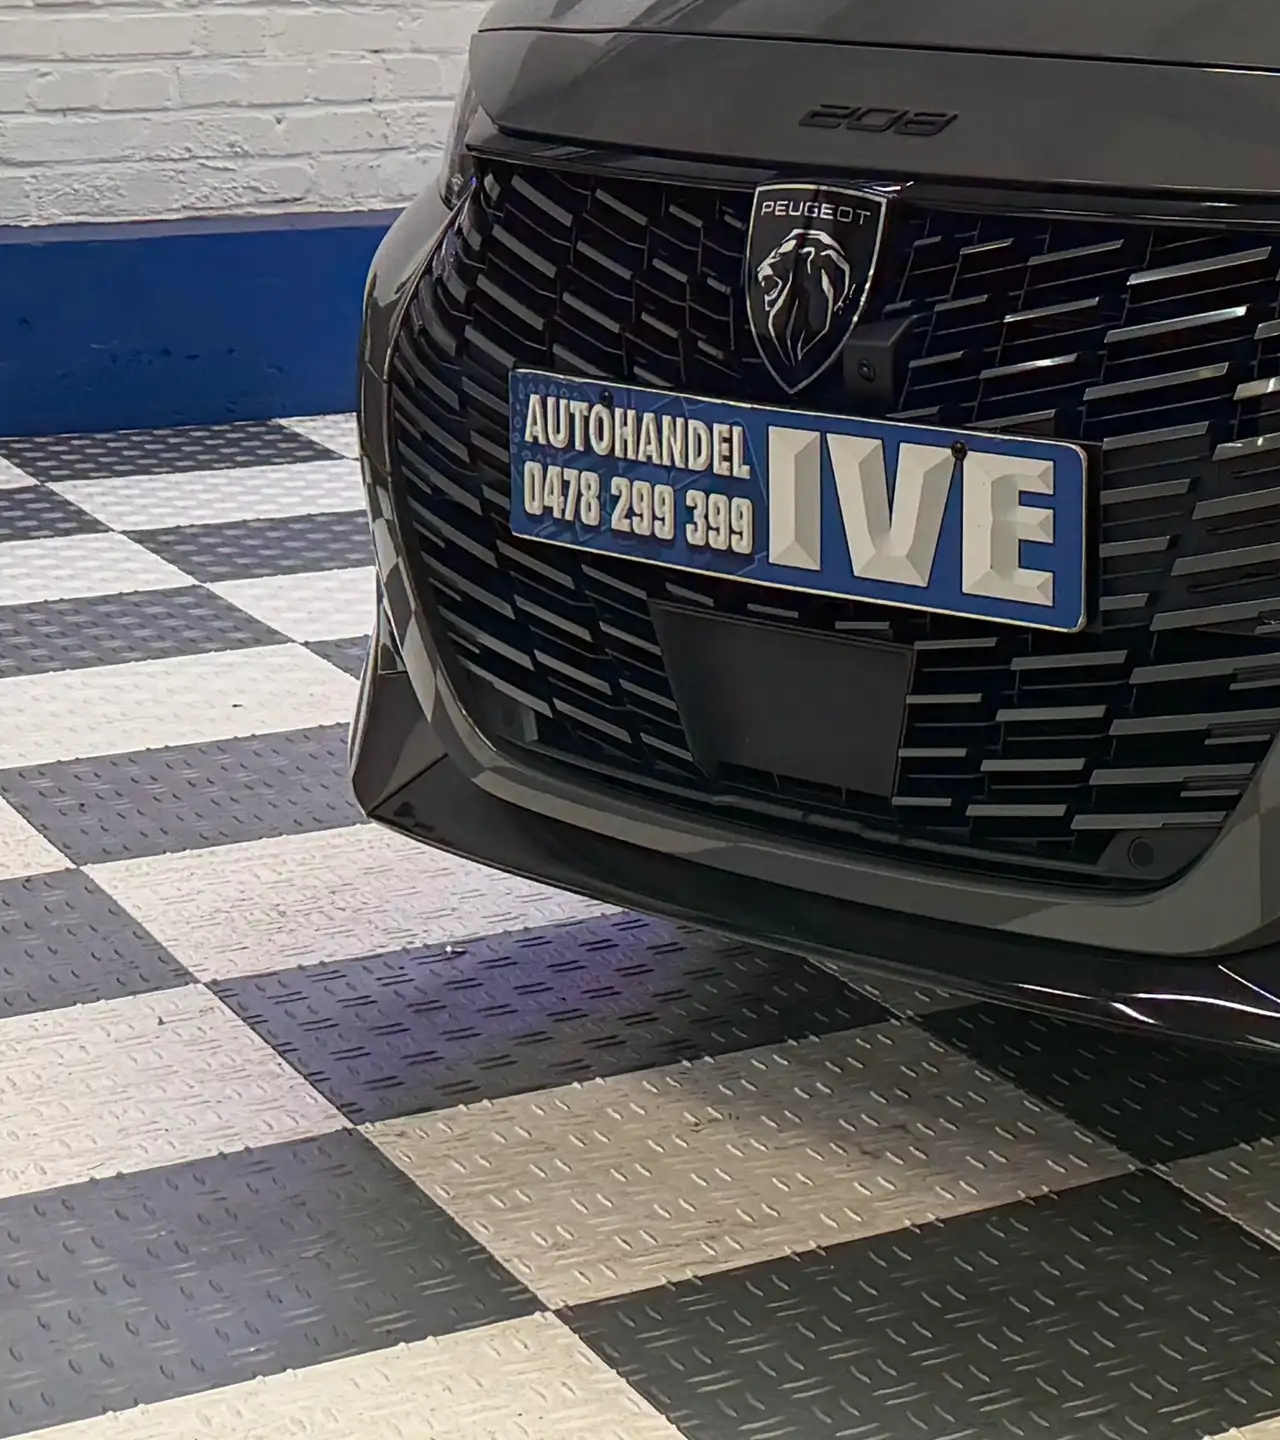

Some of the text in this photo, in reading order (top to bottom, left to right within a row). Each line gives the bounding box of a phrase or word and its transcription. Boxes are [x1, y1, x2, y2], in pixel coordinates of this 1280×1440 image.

[799, 104, 958, 137] 208
[760, 200, 872, 225] PEUGEOT
[524, 393, 751, 479] AUTOHANDEL
[523, 460, 754, 554] 0478 299 399
[768, 425, 1054, 607] IVE
